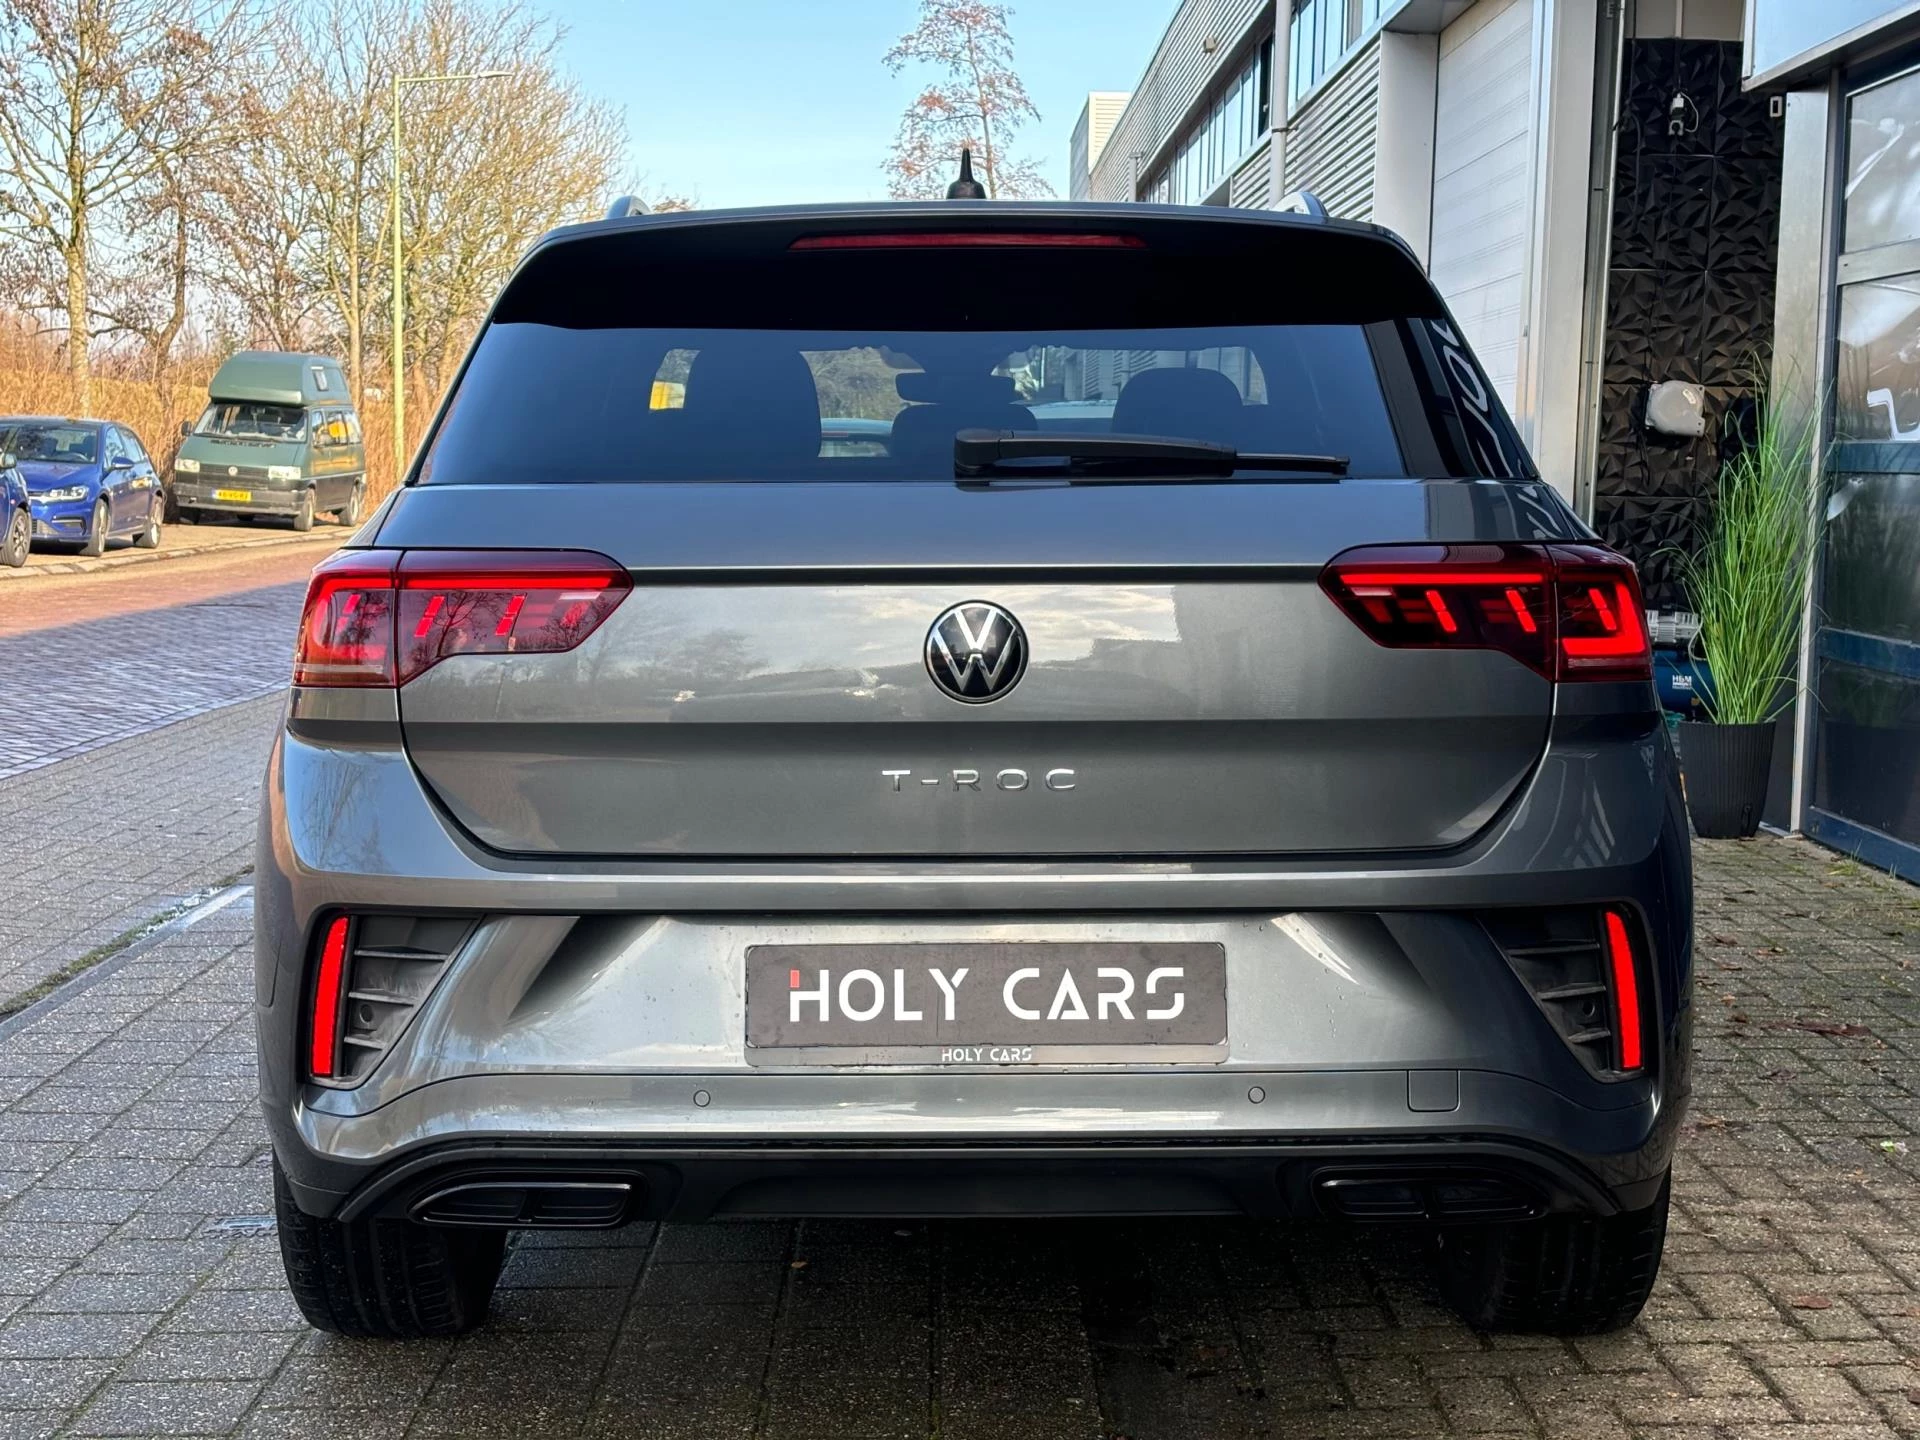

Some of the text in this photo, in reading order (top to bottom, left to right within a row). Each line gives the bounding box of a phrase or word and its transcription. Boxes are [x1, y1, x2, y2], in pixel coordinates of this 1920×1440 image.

[882, 768, 1076, 792] T-ROC
[789, 967, 1185, 1022] HOLY CARS
[941, 1047, 1032, 1062] HOLY CARS
